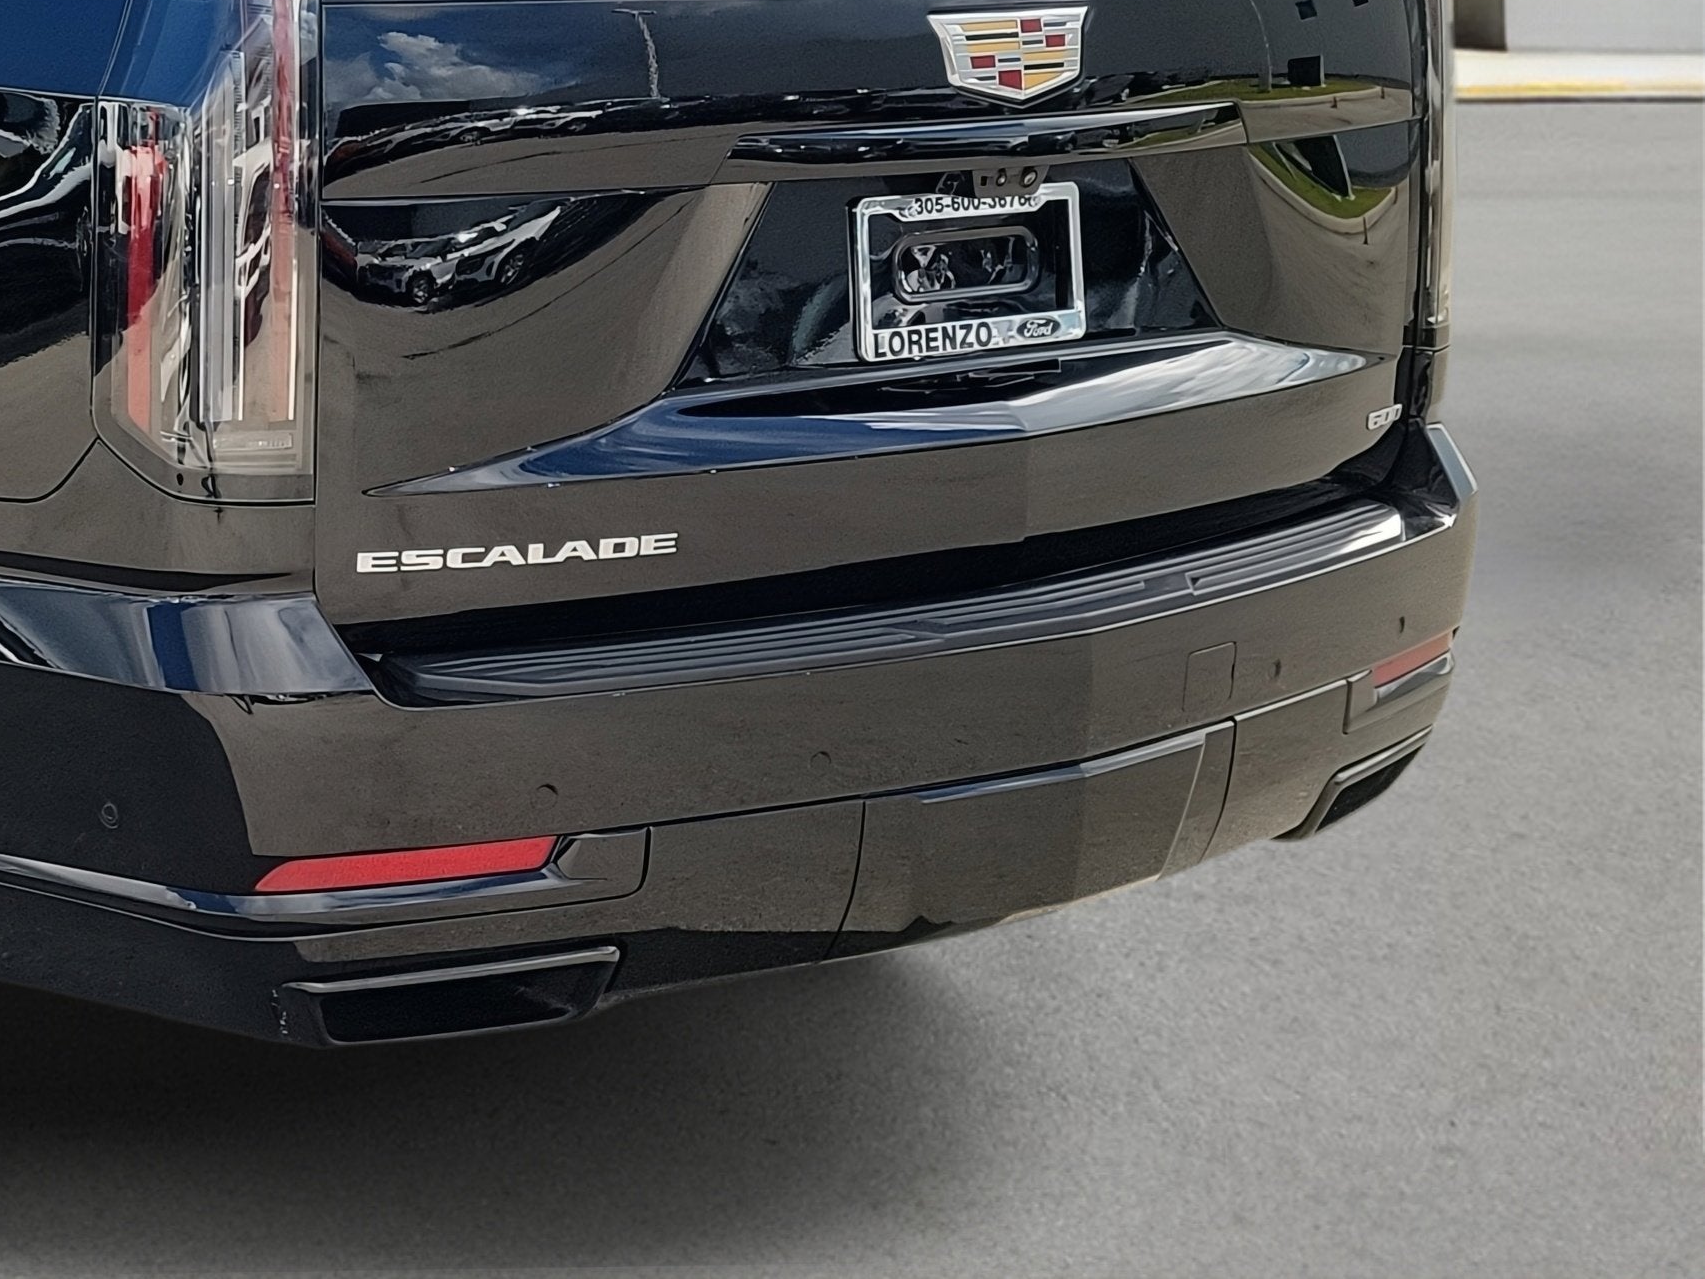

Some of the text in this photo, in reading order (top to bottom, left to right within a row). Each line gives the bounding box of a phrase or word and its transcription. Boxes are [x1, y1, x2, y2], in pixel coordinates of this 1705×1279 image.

[874, 318, 1054, 359] LORENZO Ford
[355, 532, 679, 573] ESCALADE
